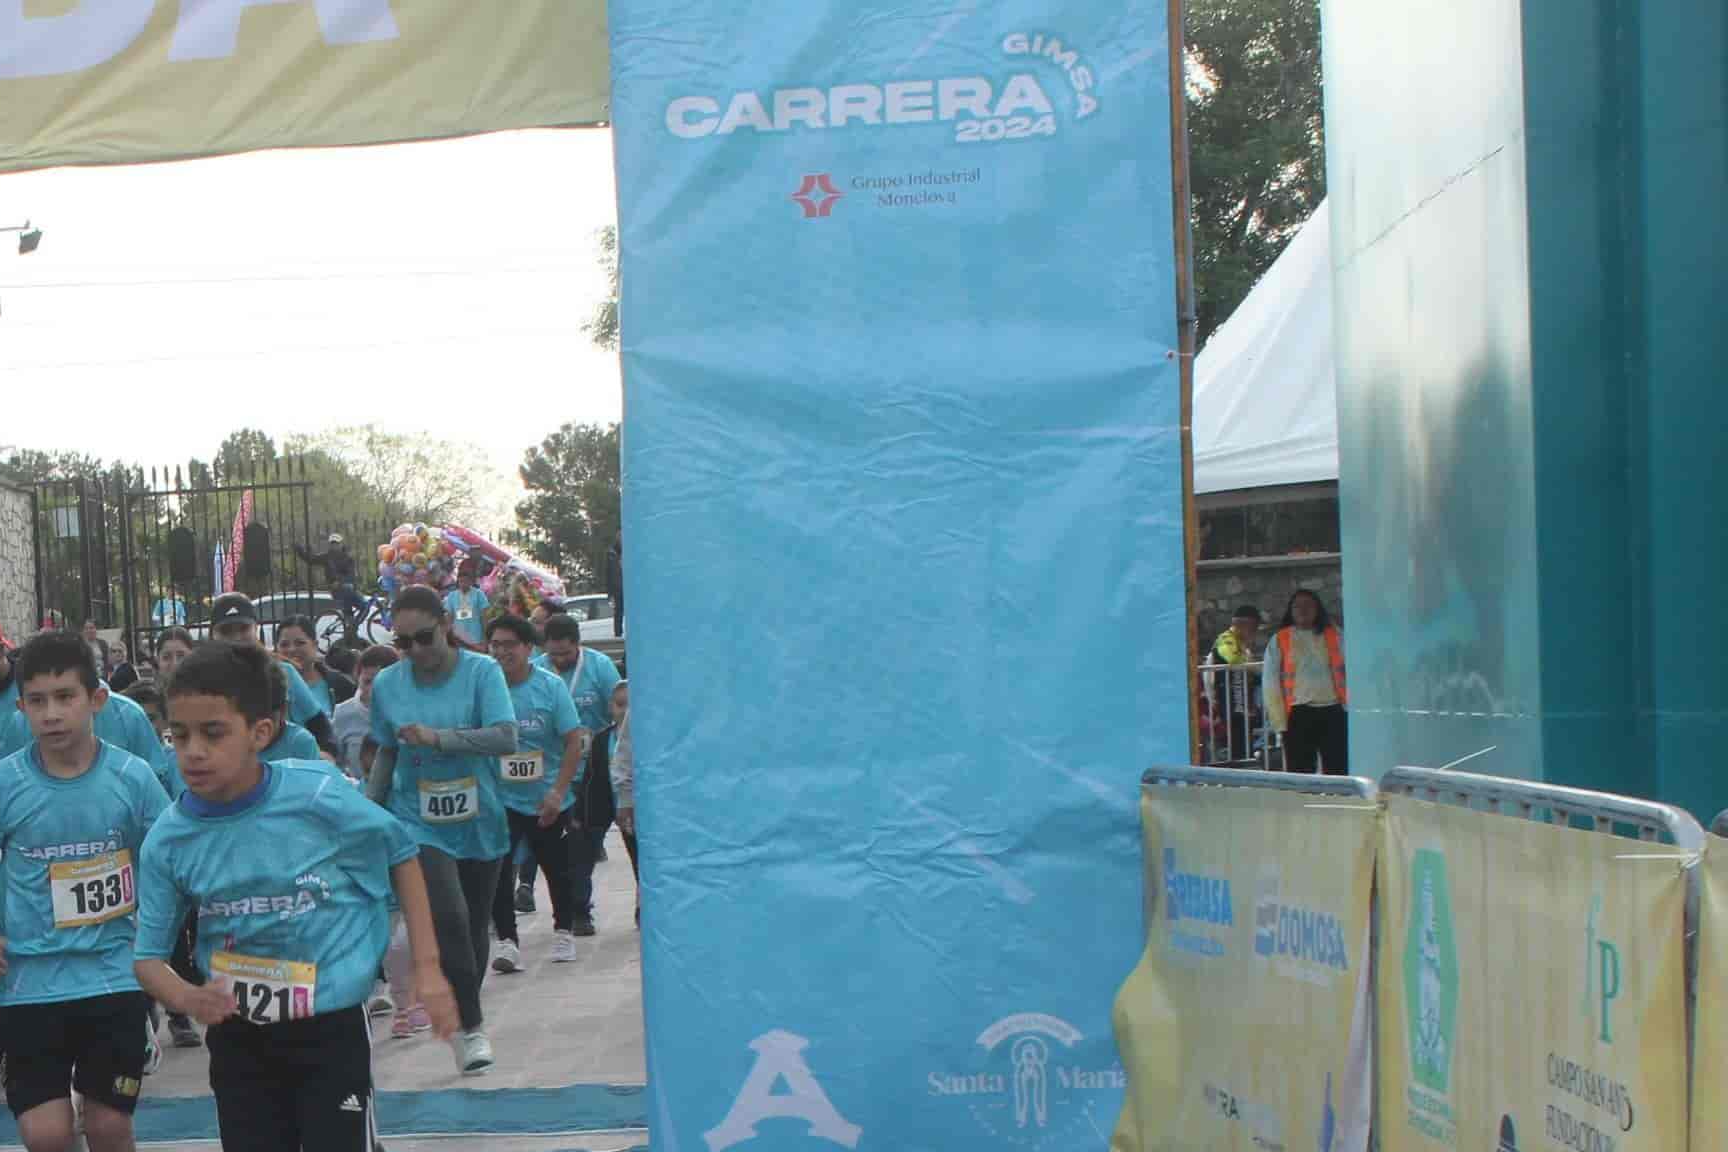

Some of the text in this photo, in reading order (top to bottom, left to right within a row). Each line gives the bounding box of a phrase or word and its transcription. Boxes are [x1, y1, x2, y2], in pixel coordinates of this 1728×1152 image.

[1003, 33, 1098, 119] GIMSA
[666, 74, 1054, 138] CARRERA
[955, 115, 1057, 143] 2024
[508, 761, 535, 778] 307
[427, 793, 468, 816] 402
[70, 873, 122, 915] 133
[927, 1070, 1007, 1097] Santa
